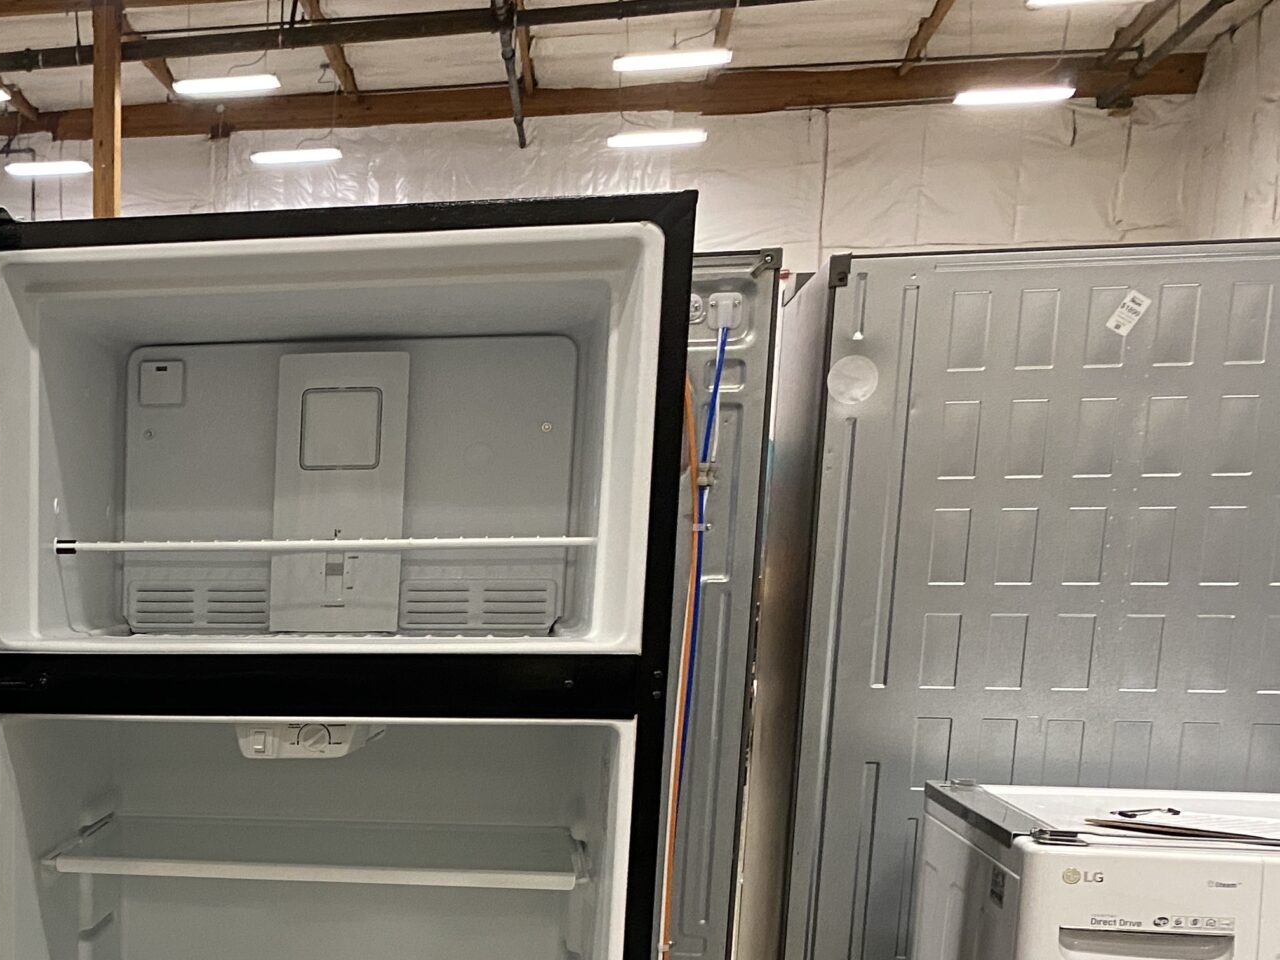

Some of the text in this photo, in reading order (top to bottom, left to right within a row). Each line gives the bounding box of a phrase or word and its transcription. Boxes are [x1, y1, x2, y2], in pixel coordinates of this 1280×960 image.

[1083, 871, 1104, 883] LG
[1090, 917, 1142, 928] Direct Drive
